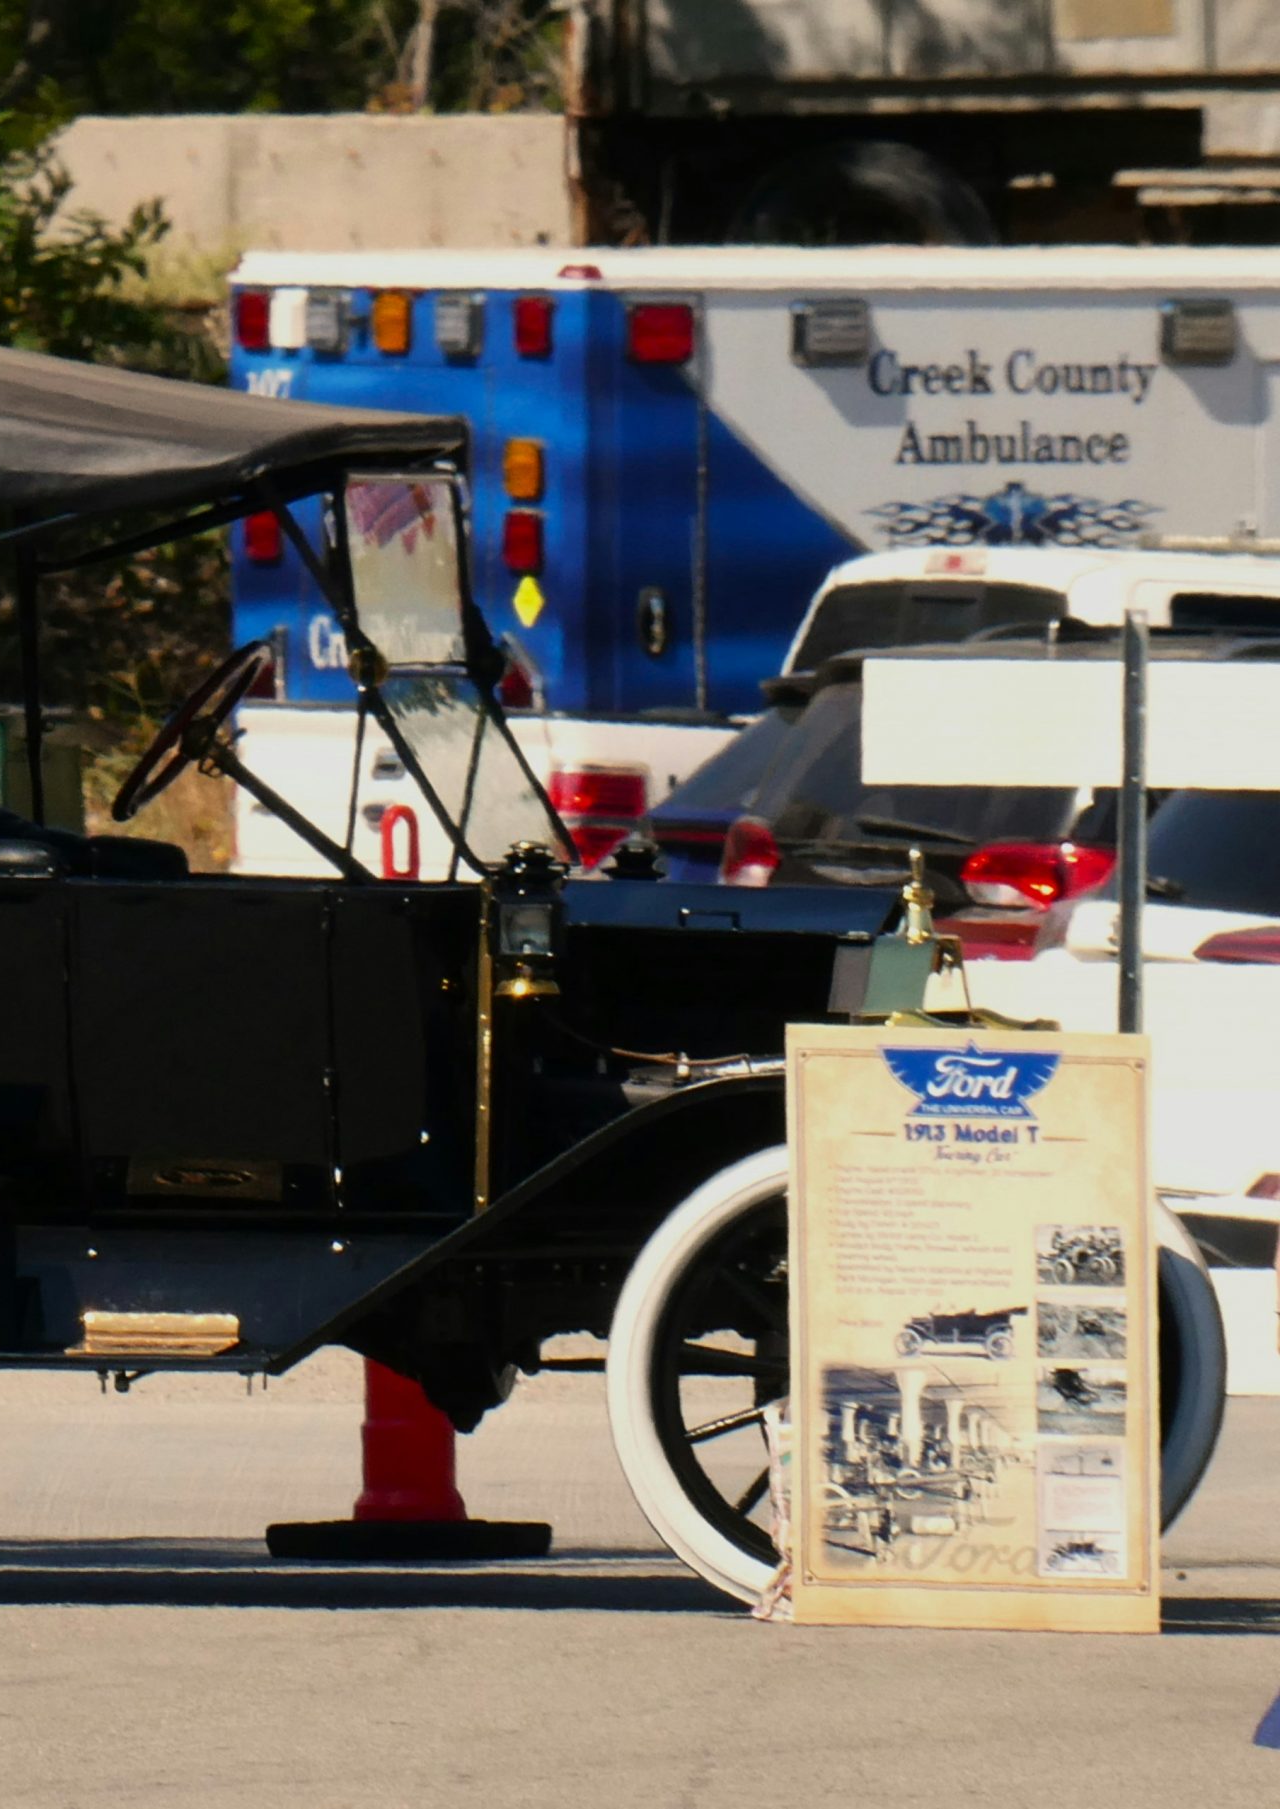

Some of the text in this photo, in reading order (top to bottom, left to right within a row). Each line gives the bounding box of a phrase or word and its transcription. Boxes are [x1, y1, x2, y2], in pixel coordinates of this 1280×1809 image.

[869, 350, 1157, 404] Creek County
[896, 420, 1130, 465] Ambulance
[926, 1054, 1019, 1099] Ford
[921, 1103, 942, 1114] THE
[943, 1104, 999, 1115] UNIVERSAL
[904, 1123, 1039, 1144] 1913 Model T
